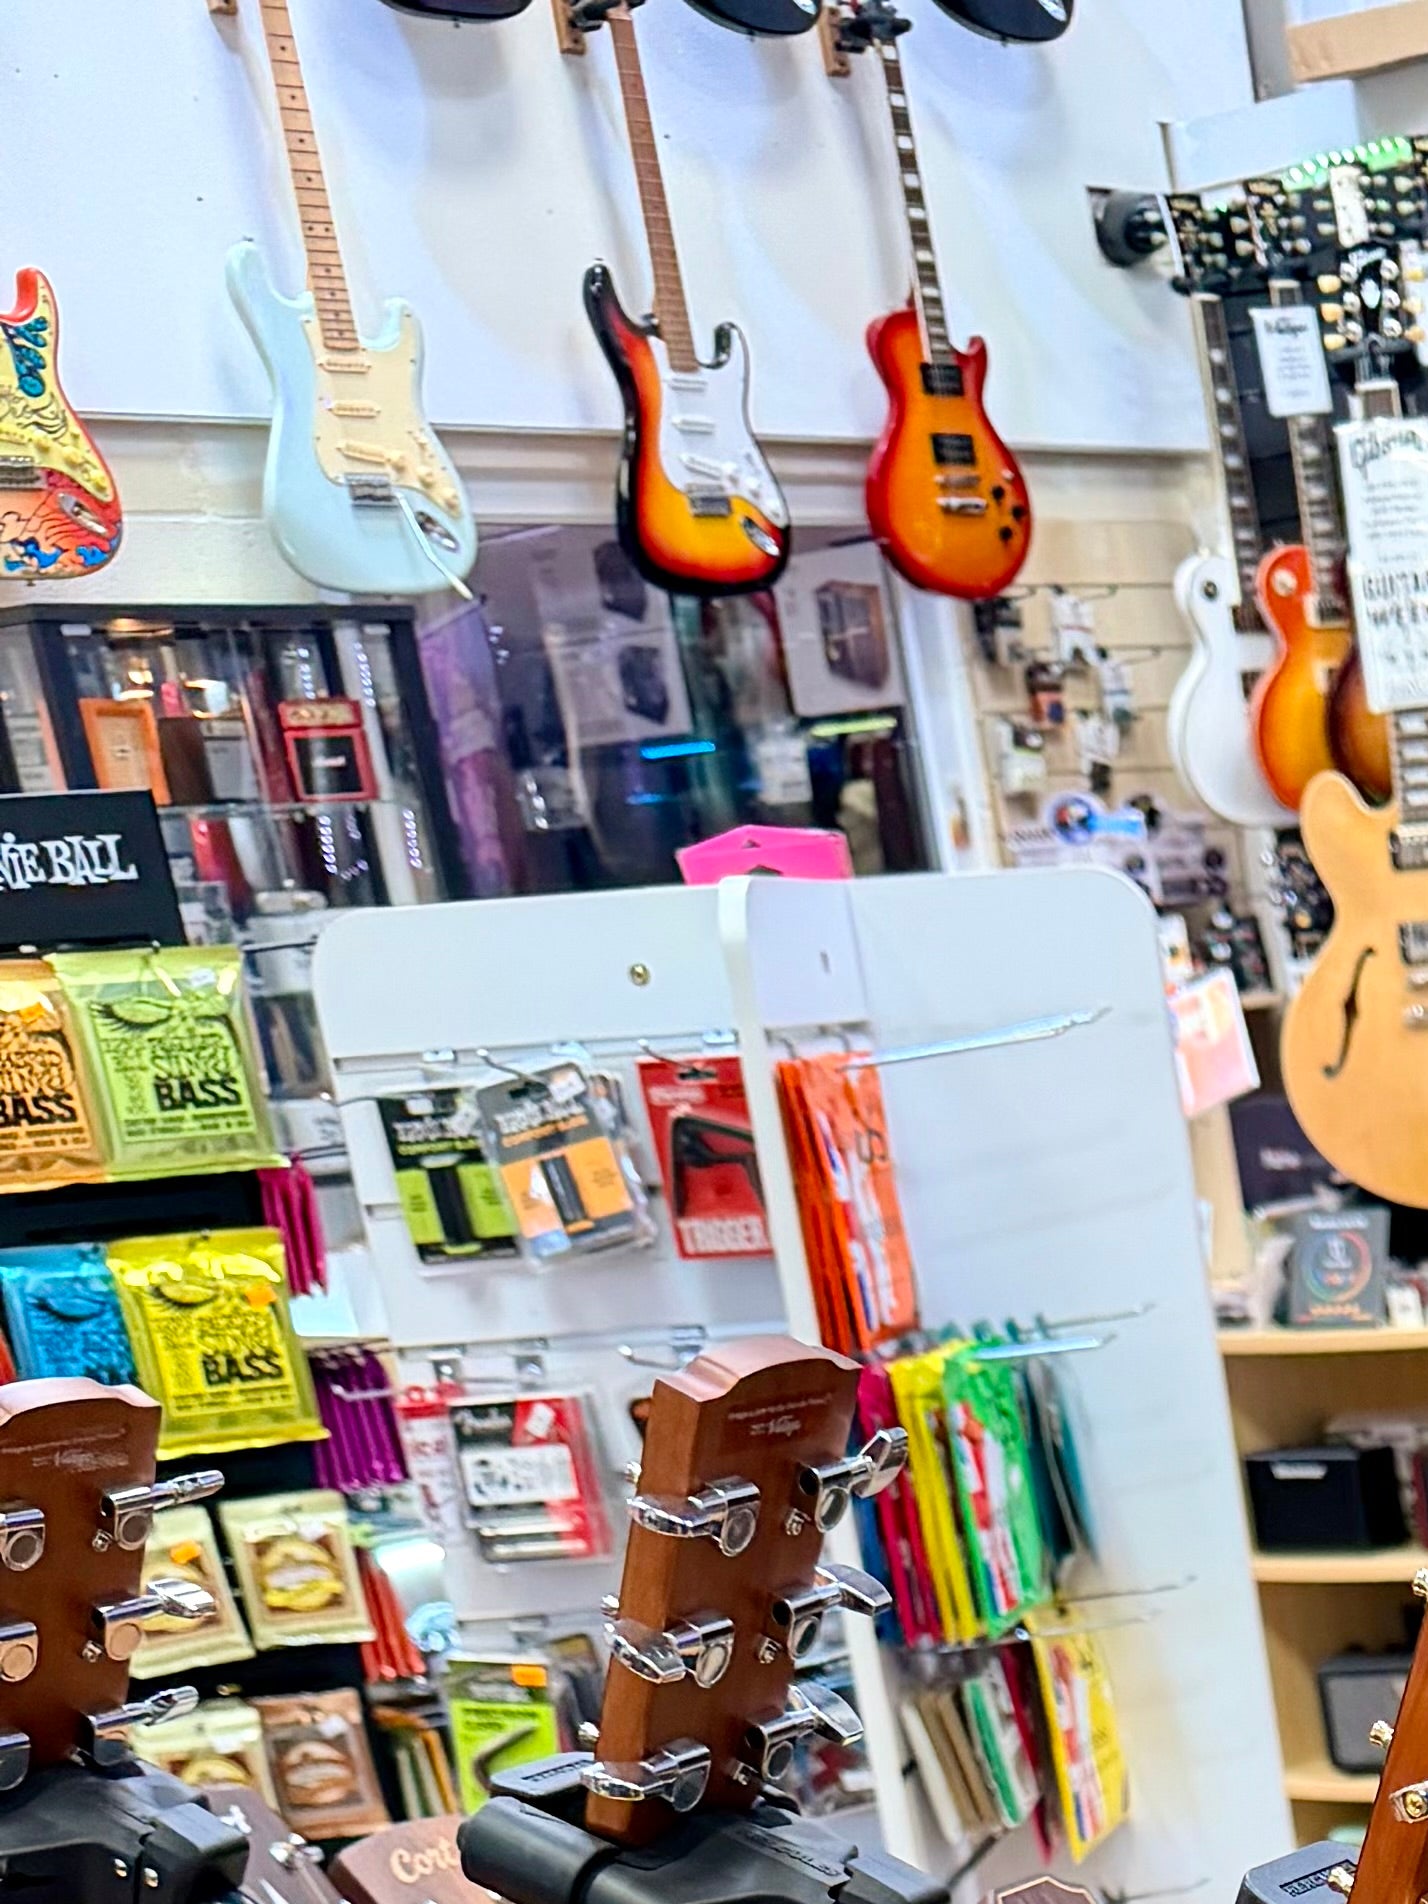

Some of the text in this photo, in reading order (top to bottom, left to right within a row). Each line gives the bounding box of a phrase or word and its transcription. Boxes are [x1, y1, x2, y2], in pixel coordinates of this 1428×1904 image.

[0, 832, 139, 890] NIE BALL
[154, 1077, 242, 1112] BASS
[202, 1350, 284, 1386] BASS
[390, 1836, 461, 1885] Cort
